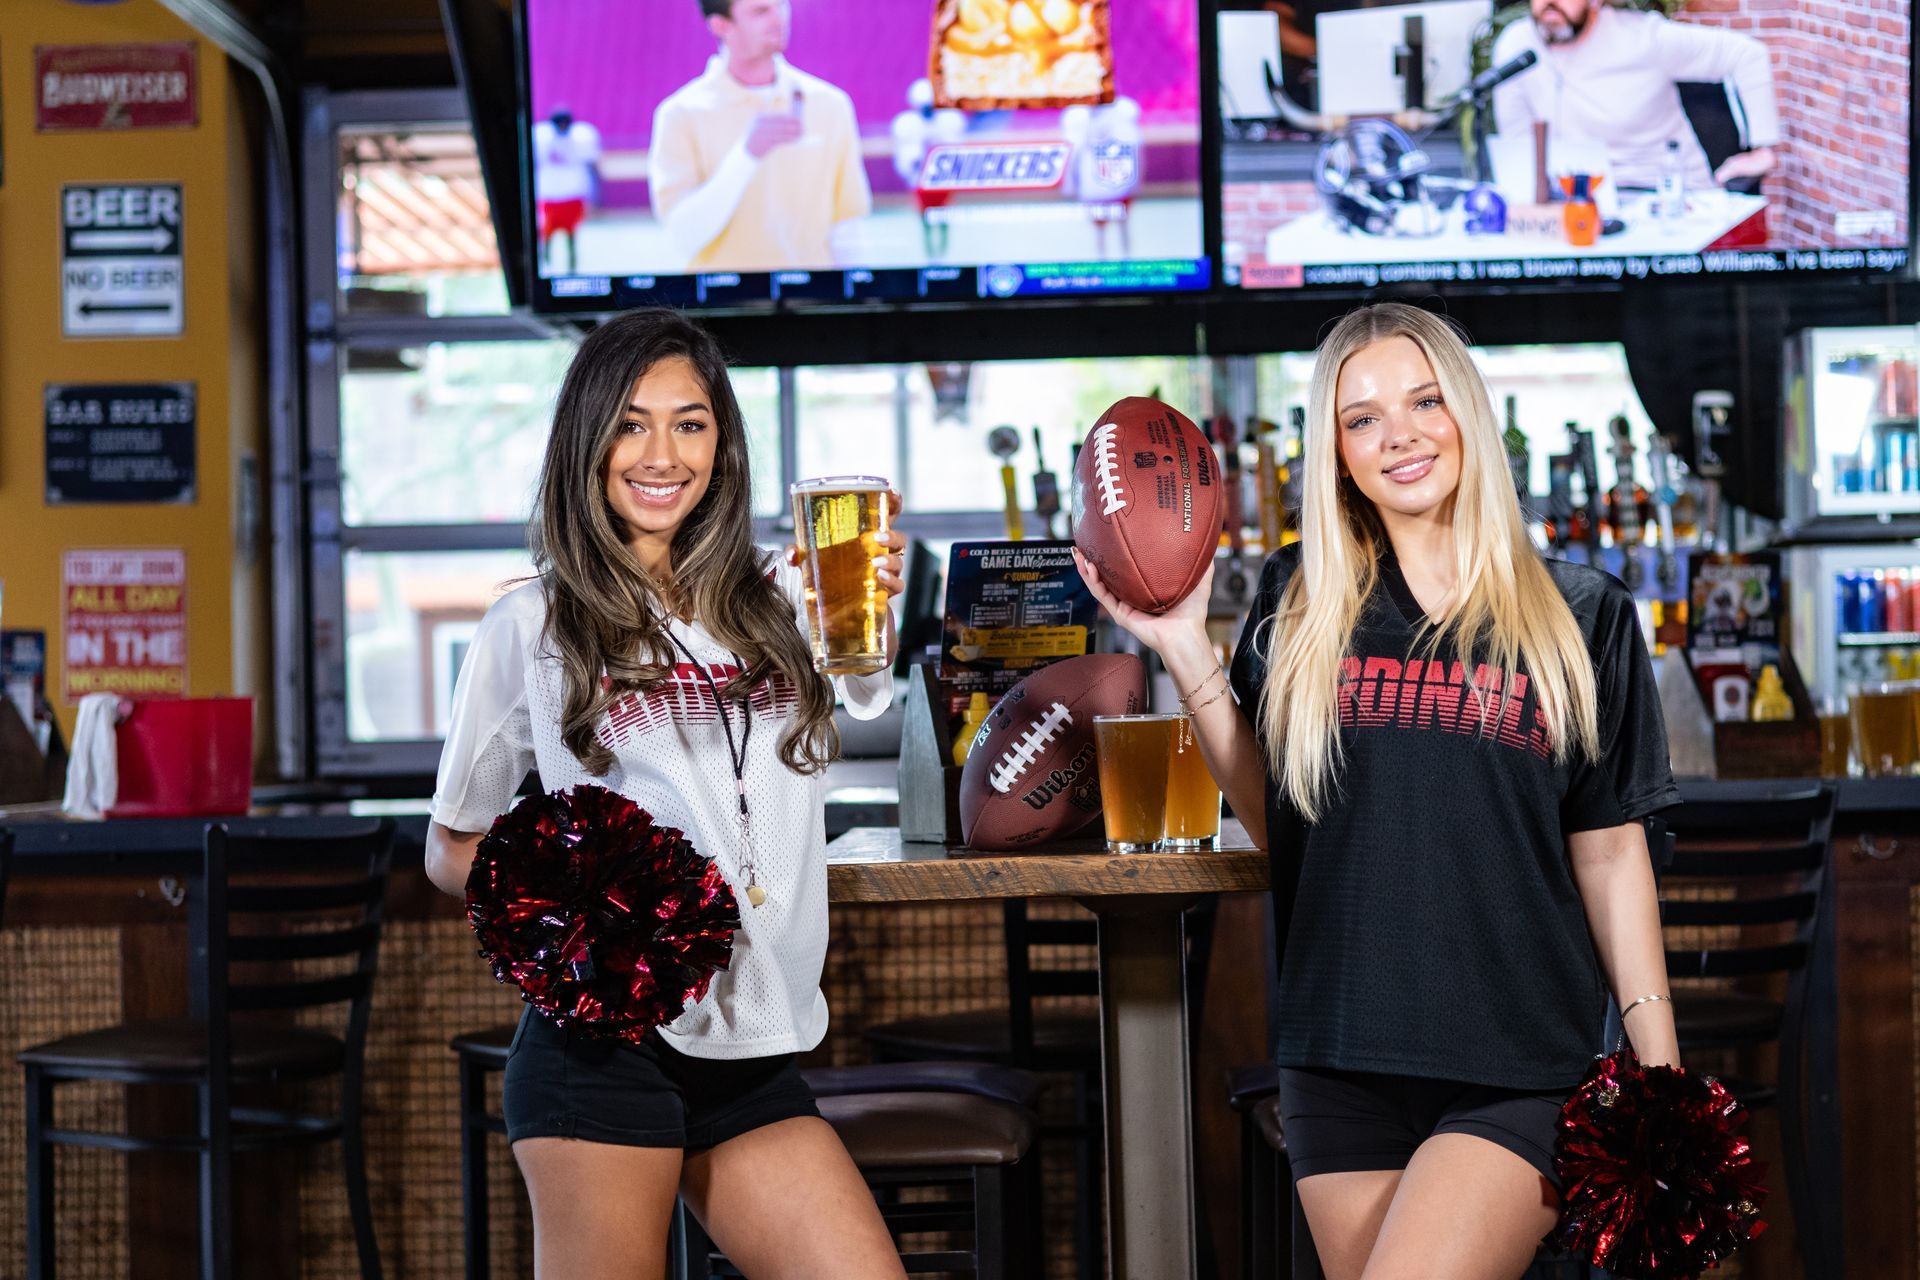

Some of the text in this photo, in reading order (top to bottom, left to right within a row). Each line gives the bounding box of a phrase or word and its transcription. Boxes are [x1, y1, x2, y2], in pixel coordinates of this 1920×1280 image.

[43, 71, 187, 107] BUDWEISER
[930, 150, 1060, 182] SNICKERS
[65, 189, 178, 226] BEER
[66, 266, 176, 291] NO BEER
[1380, 262, 1456, 282] combine
[1487, 264, 1522, 279] was
[1523, 256, 1577, 279] blown
[1578, 261, 1625, 279] away
[1626, 255, 1650, 278] by
[1651, 253, 1701, 274] Caleb
[49, 398, 192, 425] BAR RULES
[1197, 447, 1211, 486] Wilson
[1183, 482, 1192, 532] NATIONAL
[981, 555, 1075, 569] GAME DAY Specials
[1022, 547, 1073, 556] CHEESEBURG
[1011, 572, 1040, 581] SUNDAY
[70, 586, 181, 612] ALL DAY
[68, 633, 104, 664] IN
[111, 631, 182, 665] THE
[68, 668, 182, 691] MORNING
[1338, 656, 1551, 760] RDINAL
[1022, 743, 1097, 811] Wilson
